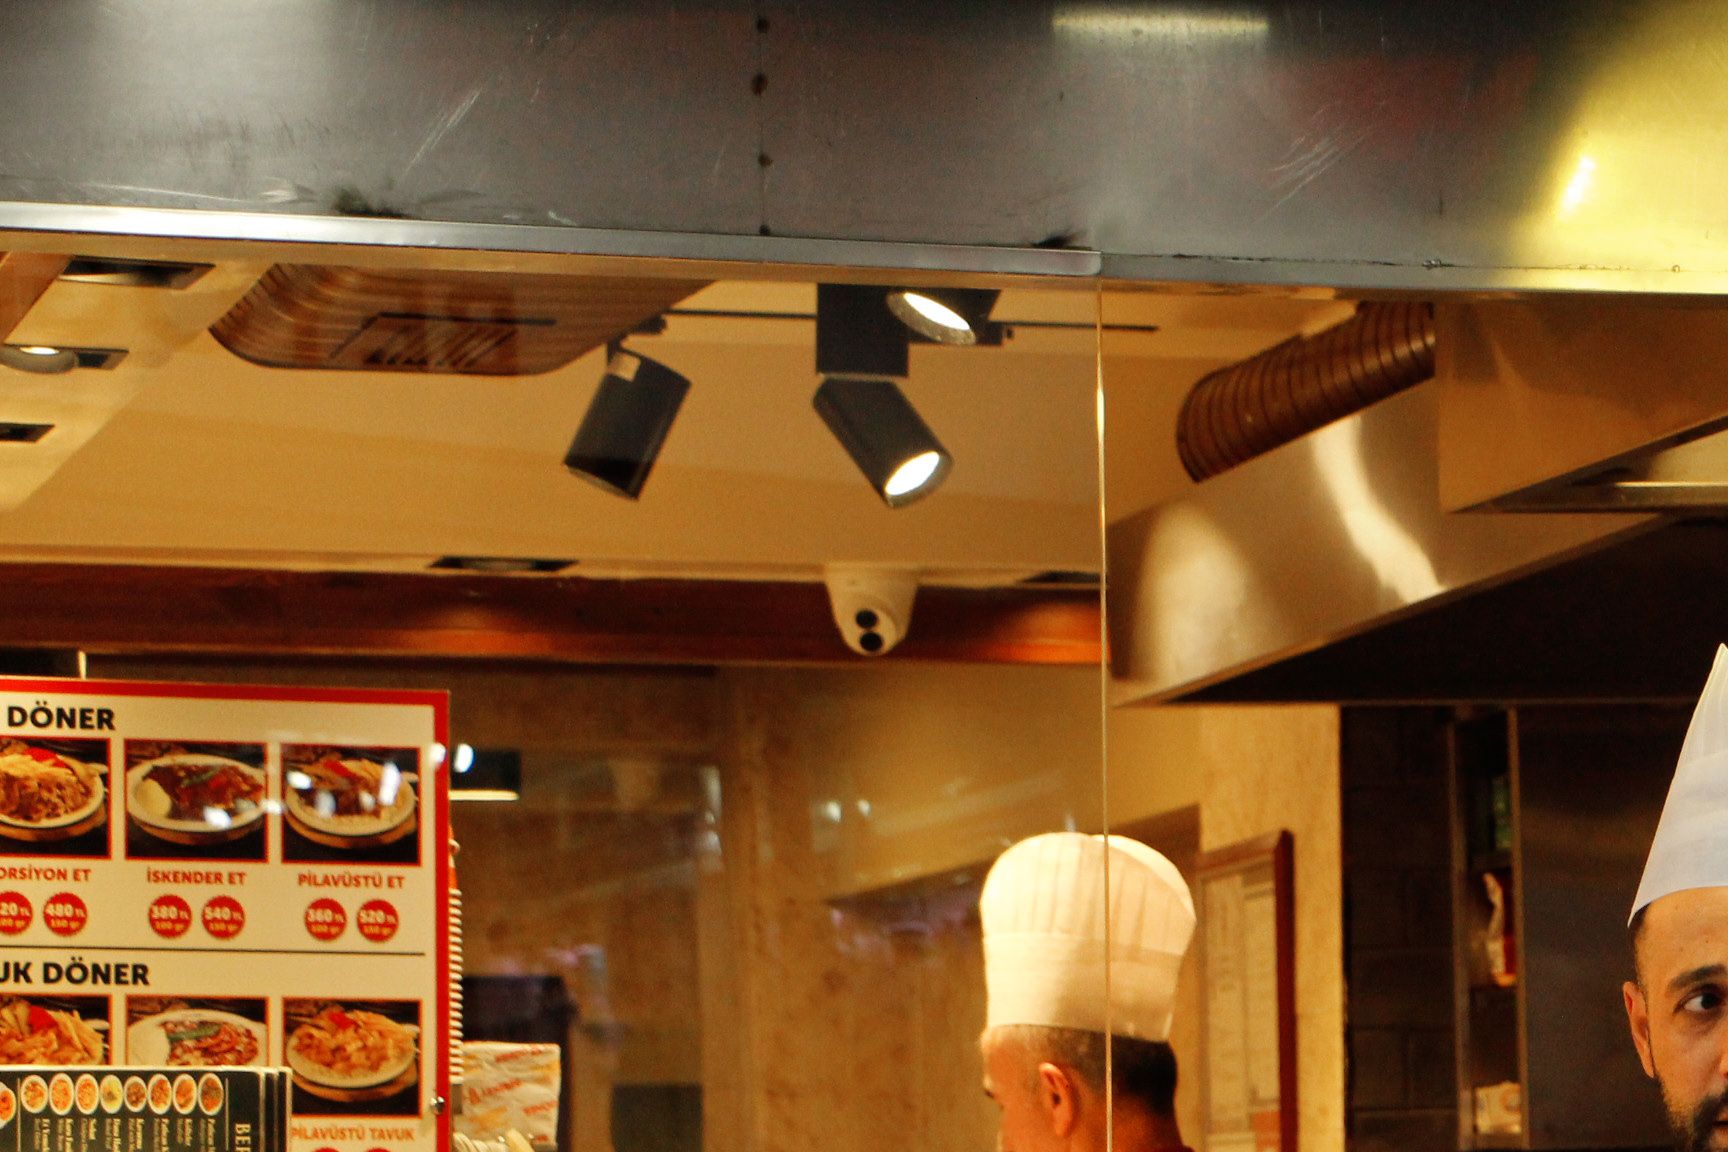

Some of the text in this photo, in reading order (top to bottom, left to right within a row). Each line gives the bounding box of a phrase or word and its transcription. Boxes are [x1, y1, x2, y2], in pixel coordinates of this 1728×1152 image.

[7, 700, 116, 731] DÖNER
[73, 868, 91, 881] ET
[146, 866, 246, 886] İSKENDER ET
[298, 870, 405, 889] PİLAVÜSTÜ ET
[43, 956, 149, 985] DÖNER
[370, 1128, 415, 1140] TAVUK
